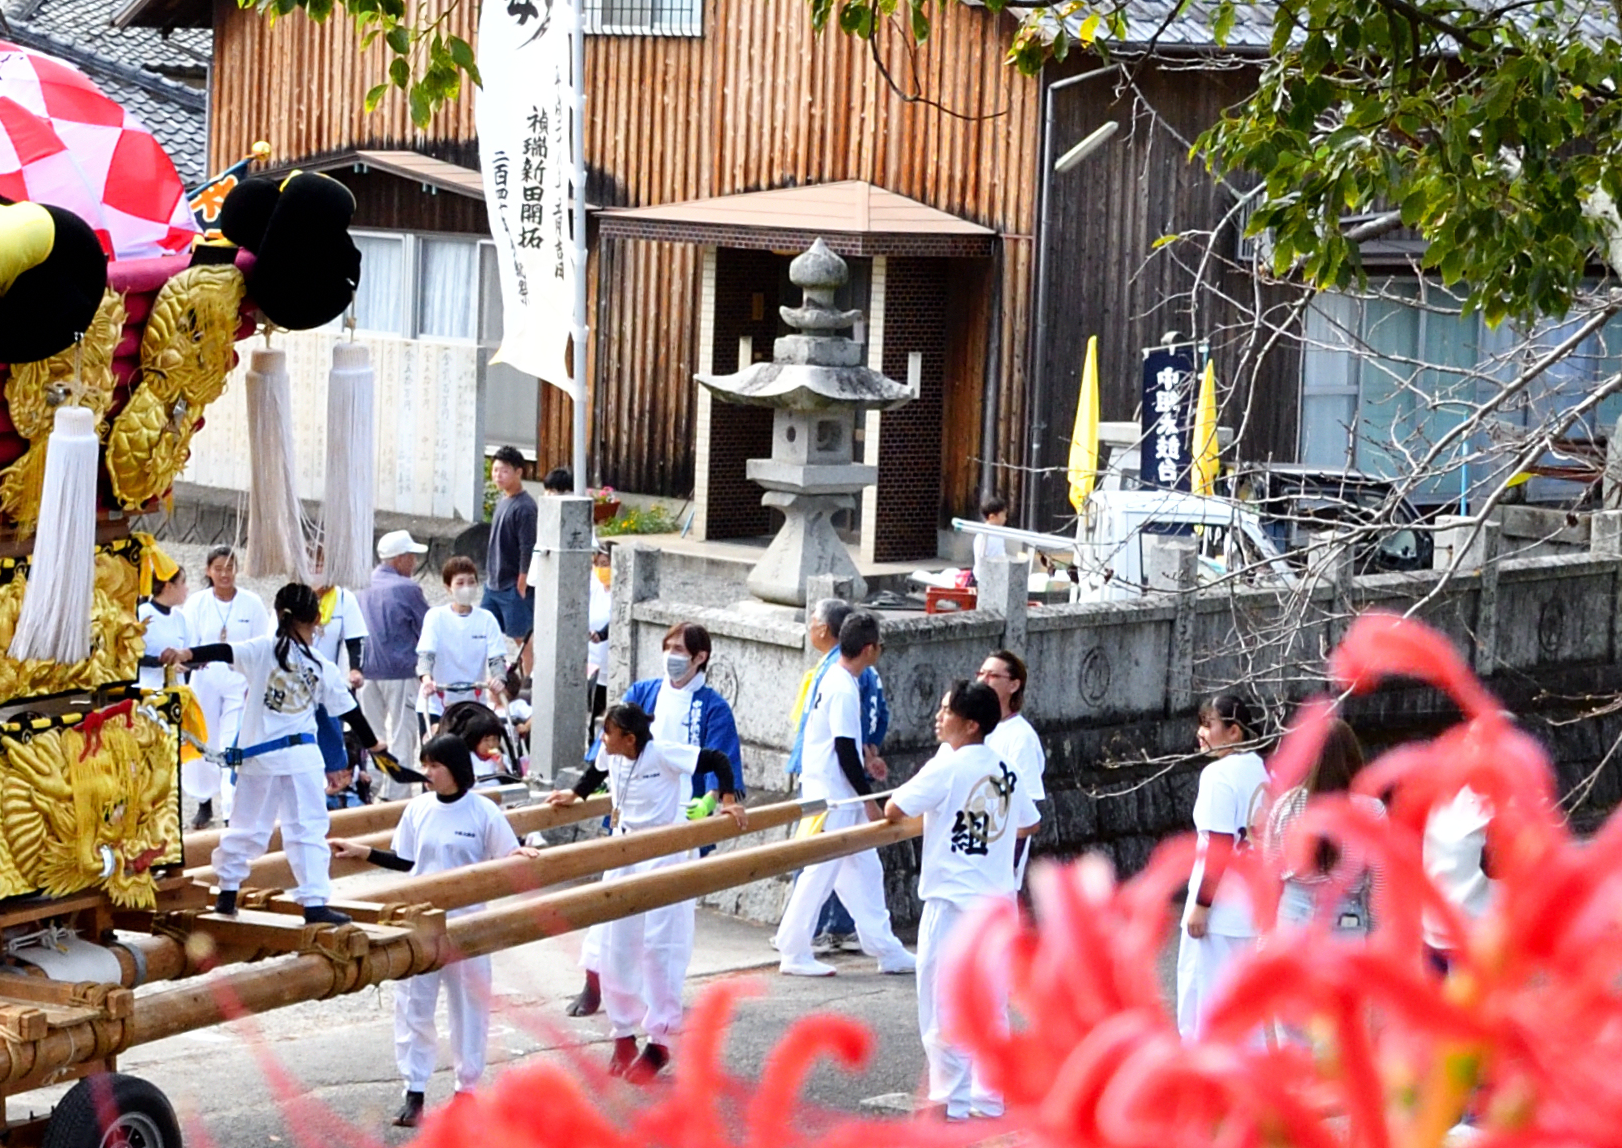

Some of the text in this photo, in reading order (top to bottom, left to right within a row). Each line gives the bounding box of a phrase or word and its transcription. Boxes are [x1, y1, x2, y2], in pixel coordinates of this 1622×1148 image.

[518, 105, 549, 249] 禎瑞新田開拓
